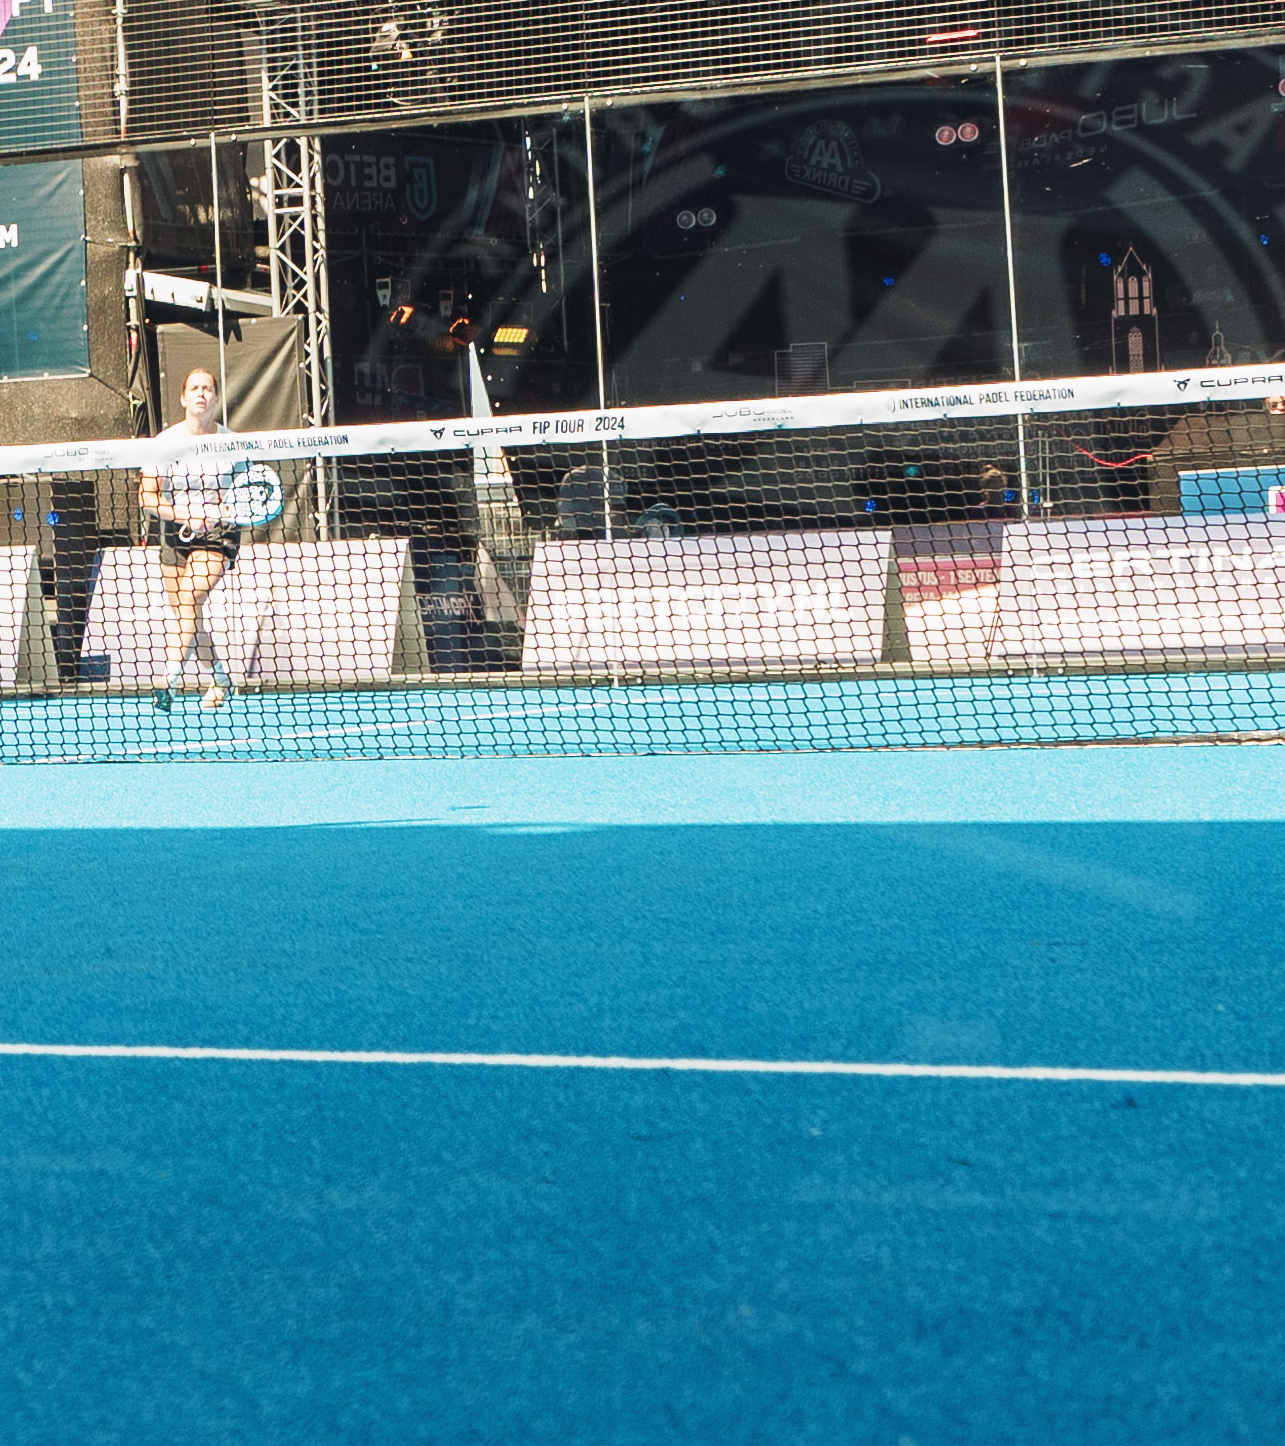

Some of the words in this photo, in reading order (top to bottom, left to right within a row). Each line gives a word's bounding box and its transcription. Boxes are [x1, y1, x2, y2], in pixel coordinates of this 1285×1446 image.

[200, 438, 264, 454] INTERNATIONAL
[268, 437, 293, 450] PADEL
[296, 434, 349, 448] FEDERATION
[452, 424, 523, 438] CUPRA
[532, 420, 550, 435] FIP
[554, 418, 585, 434] TOUR
[594, 416, 626, 432] 2024
[899, 393, 974, 411] INTERNATIONAL
[979, 390, 1010, 405] PADEL
[1013, 387, 1075, 403] FEDERATION
[1200, 374, 1284, 389] CUPRA
